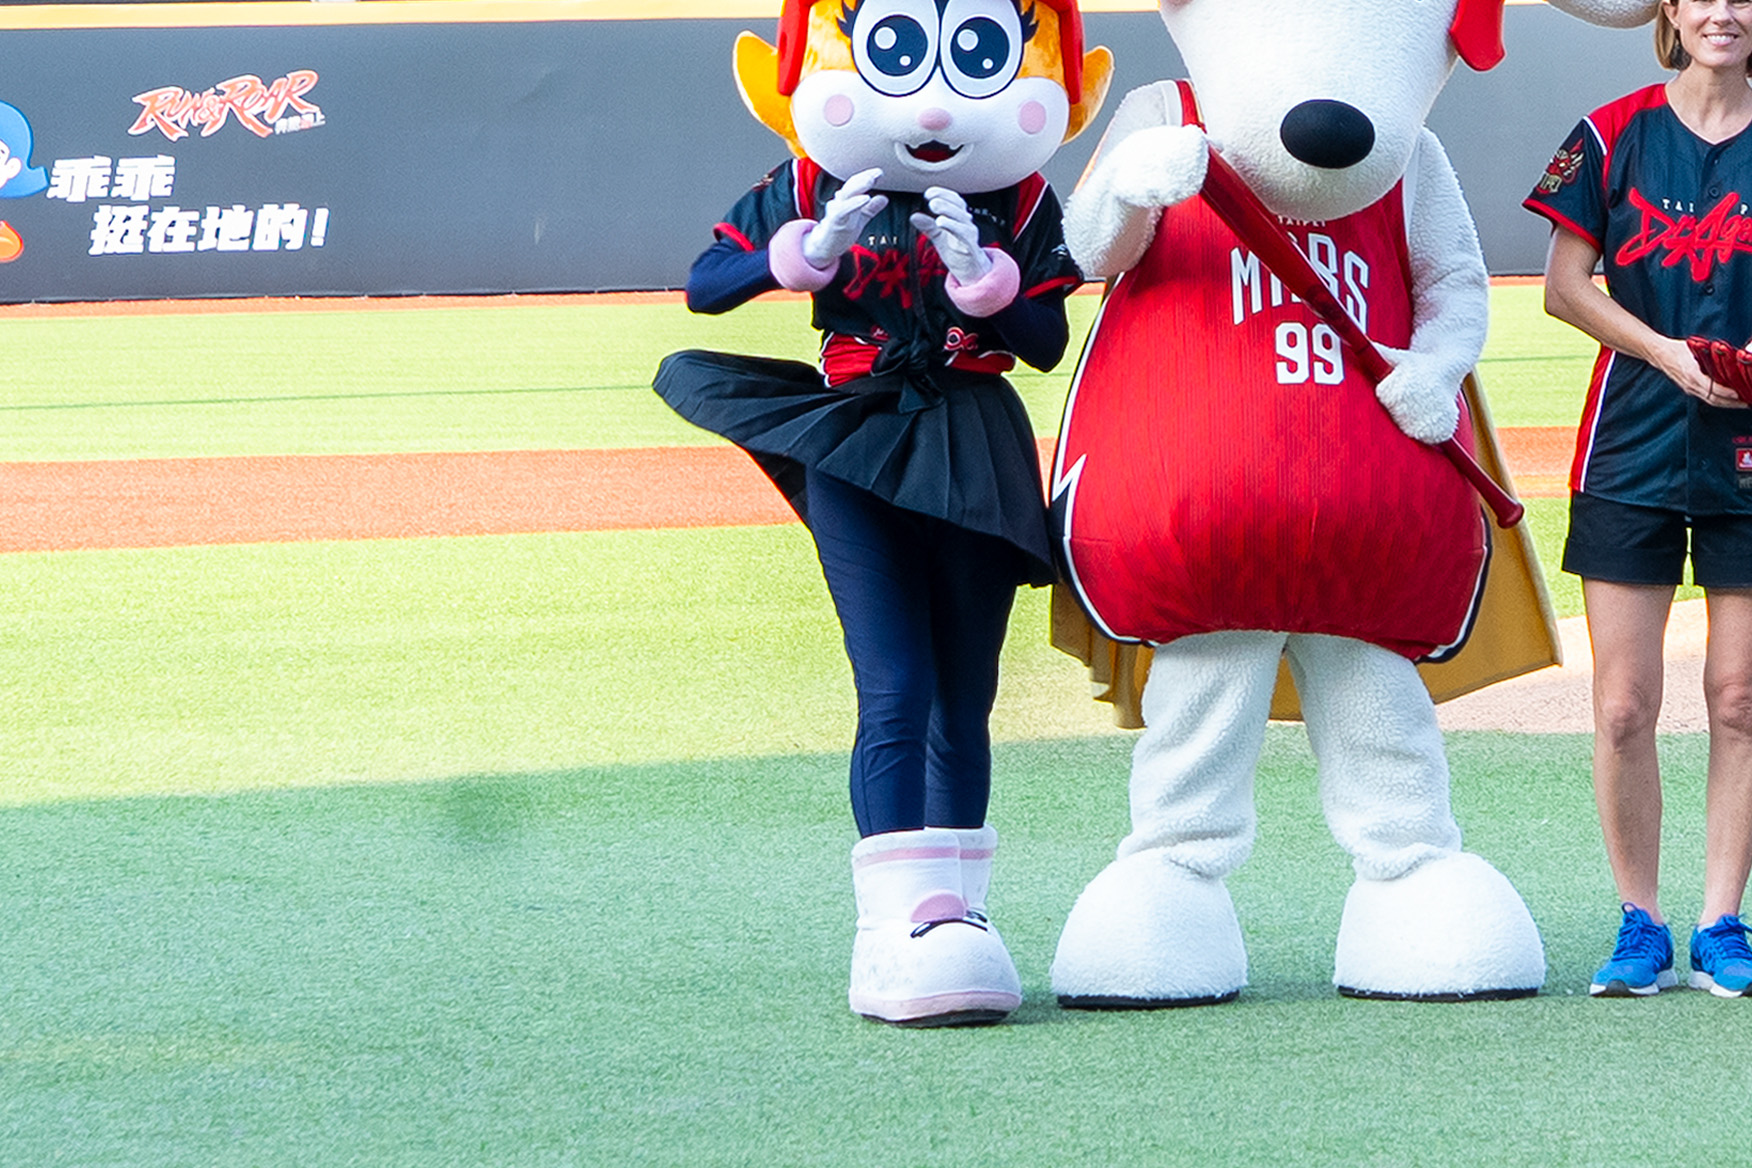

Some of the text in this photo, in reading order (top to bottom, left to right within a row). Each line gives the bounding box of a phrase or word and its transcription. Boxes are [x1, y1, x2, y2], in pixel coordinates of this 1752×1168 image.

[47, 155, 176, 201] 乖乖
[1662, 198, 1695, 213] TAI
[1275, 321, 1345, 385] 99
